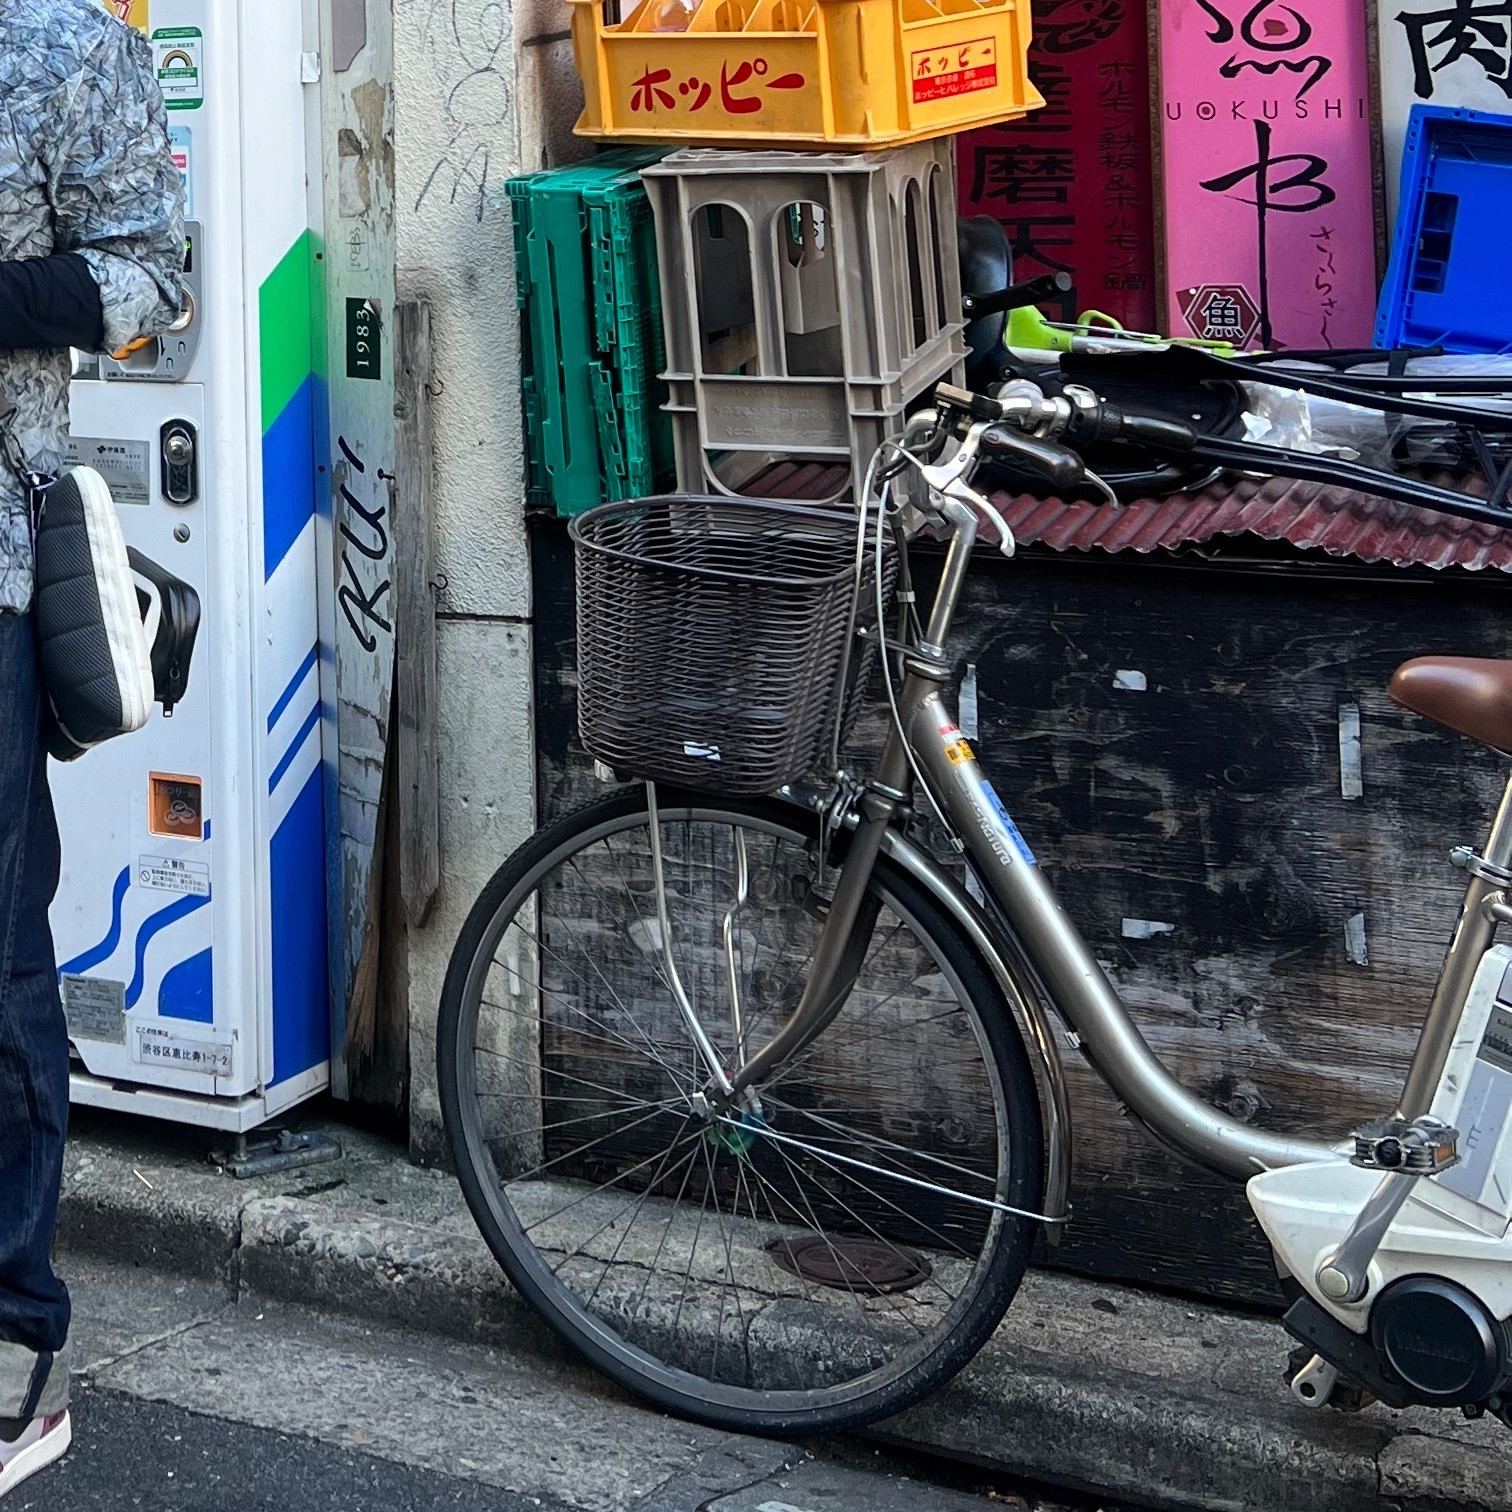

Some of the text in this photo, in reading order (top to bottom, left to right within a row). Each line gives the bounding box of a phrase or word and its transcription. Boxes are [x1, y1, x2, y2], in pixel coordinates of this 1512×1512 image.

[916, 45, 992, 77] ホッピー
[631, 57, 806, 114] ホッピー
[1166, 98, 1366, 122] UOKUSHI
[356, 308, 371, 368] 1983
[1201, 294, 1247, 339] 魚
